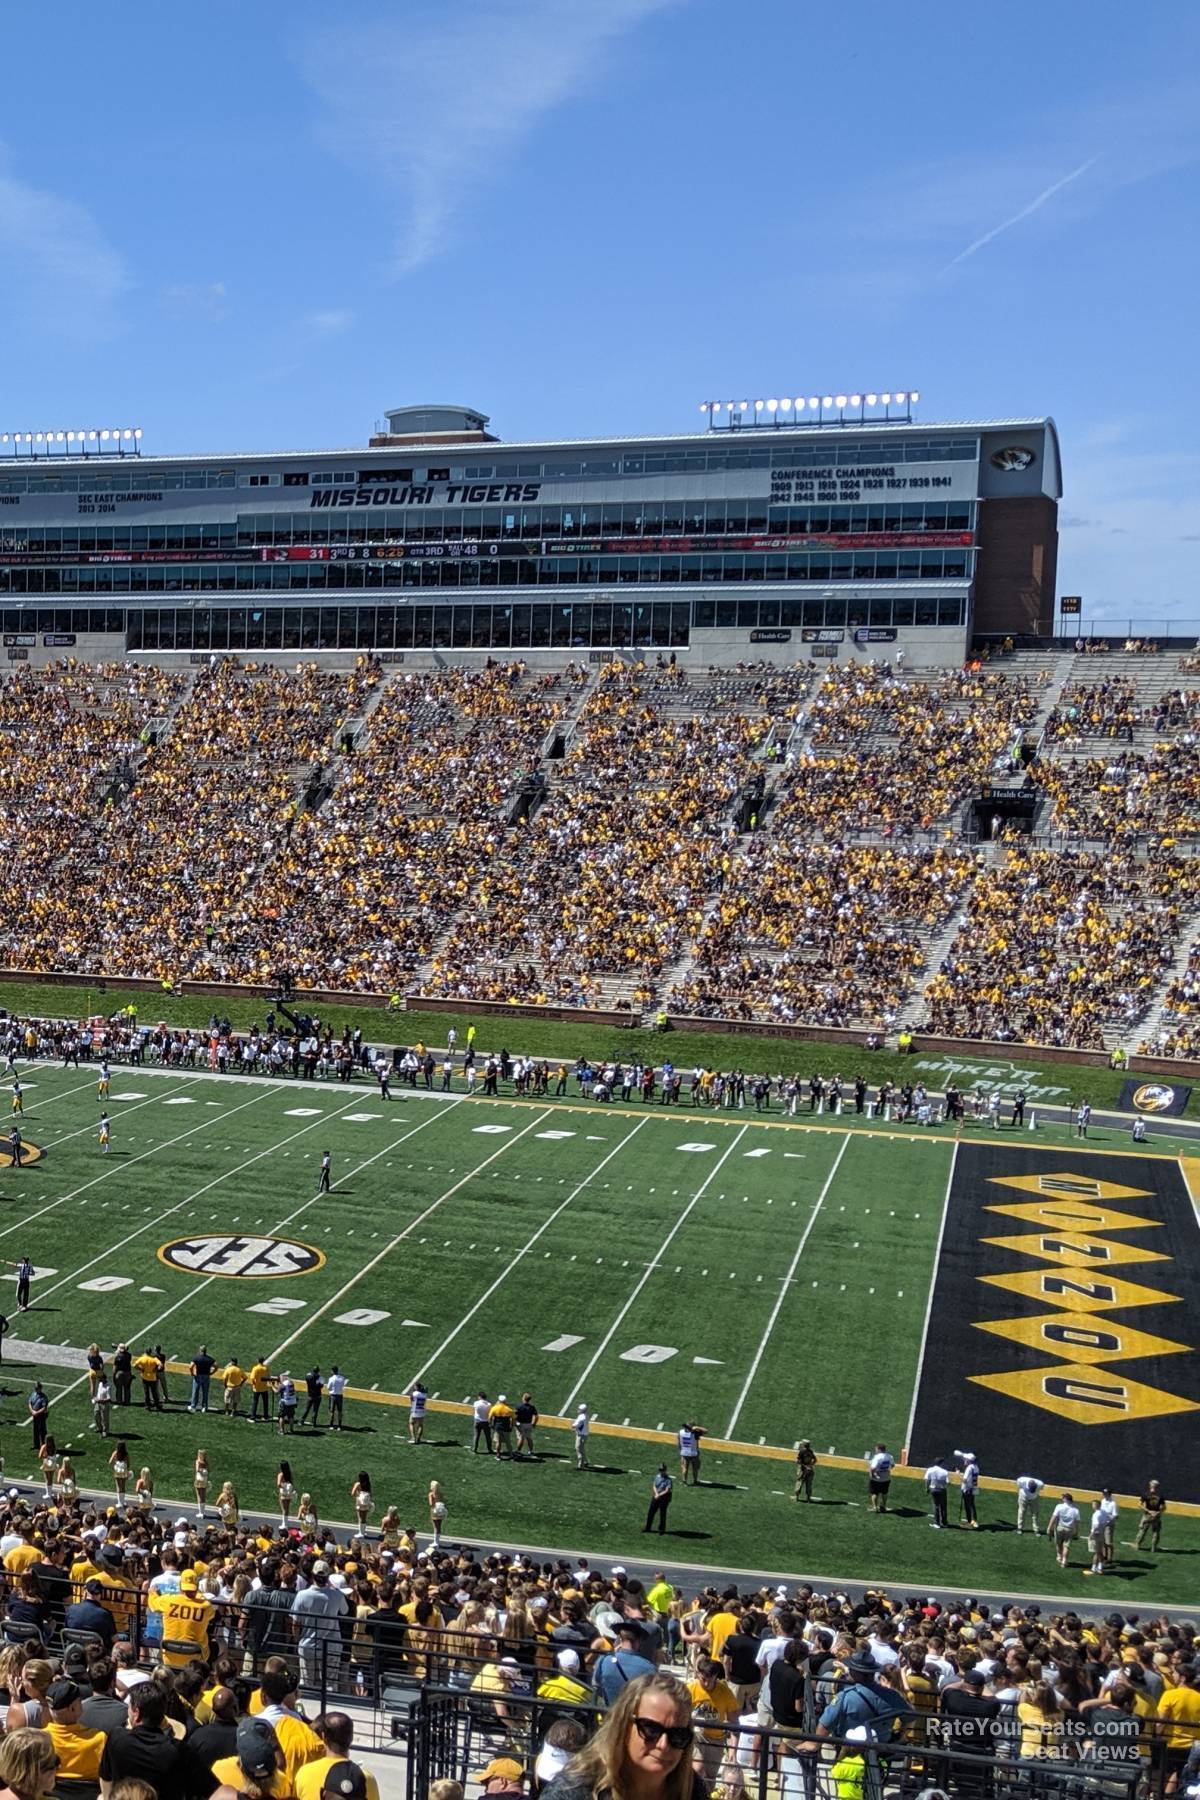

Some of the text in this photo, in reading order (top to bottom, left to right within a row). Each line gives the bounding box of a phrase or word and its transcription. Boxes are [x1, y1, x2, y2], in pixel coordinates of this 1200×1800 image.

[771, 467, 895, 481] CONFERENCE CHAMPIONS
[840, 479, 861, 490] 1924
[887, 478, 907, 489] 1927
[909, 477, 930, 488] 1939
[932, 476, 952, 487] 1941
[78, 492, 163, 504] SEC EAST CHAMPIONS
[310, 483, 542, 508] MISSOURI TIGERS
[78, 504, 116, 514] 2013 2014
[309, 548, 324, 559] 31
[363, 548, 370, 558] 8
[425, 546, 444, 557] 3RD
[464, 544, 498, 555] 48 0
[992, 790, 1035, 799] Health Care
[913, 1060, 1044, 1080] MAKE IT
[970, 1079, 1071, 1096] RIGHT
[171, 1236, 313, 1276] SEC
[1038, 1175, 1131, 1413] MIZZOU
[245, 1296, 392, 1326] 20
[540, 1333, 680, 1364] 10
[169, 1603, 206, 1622] ZOU
